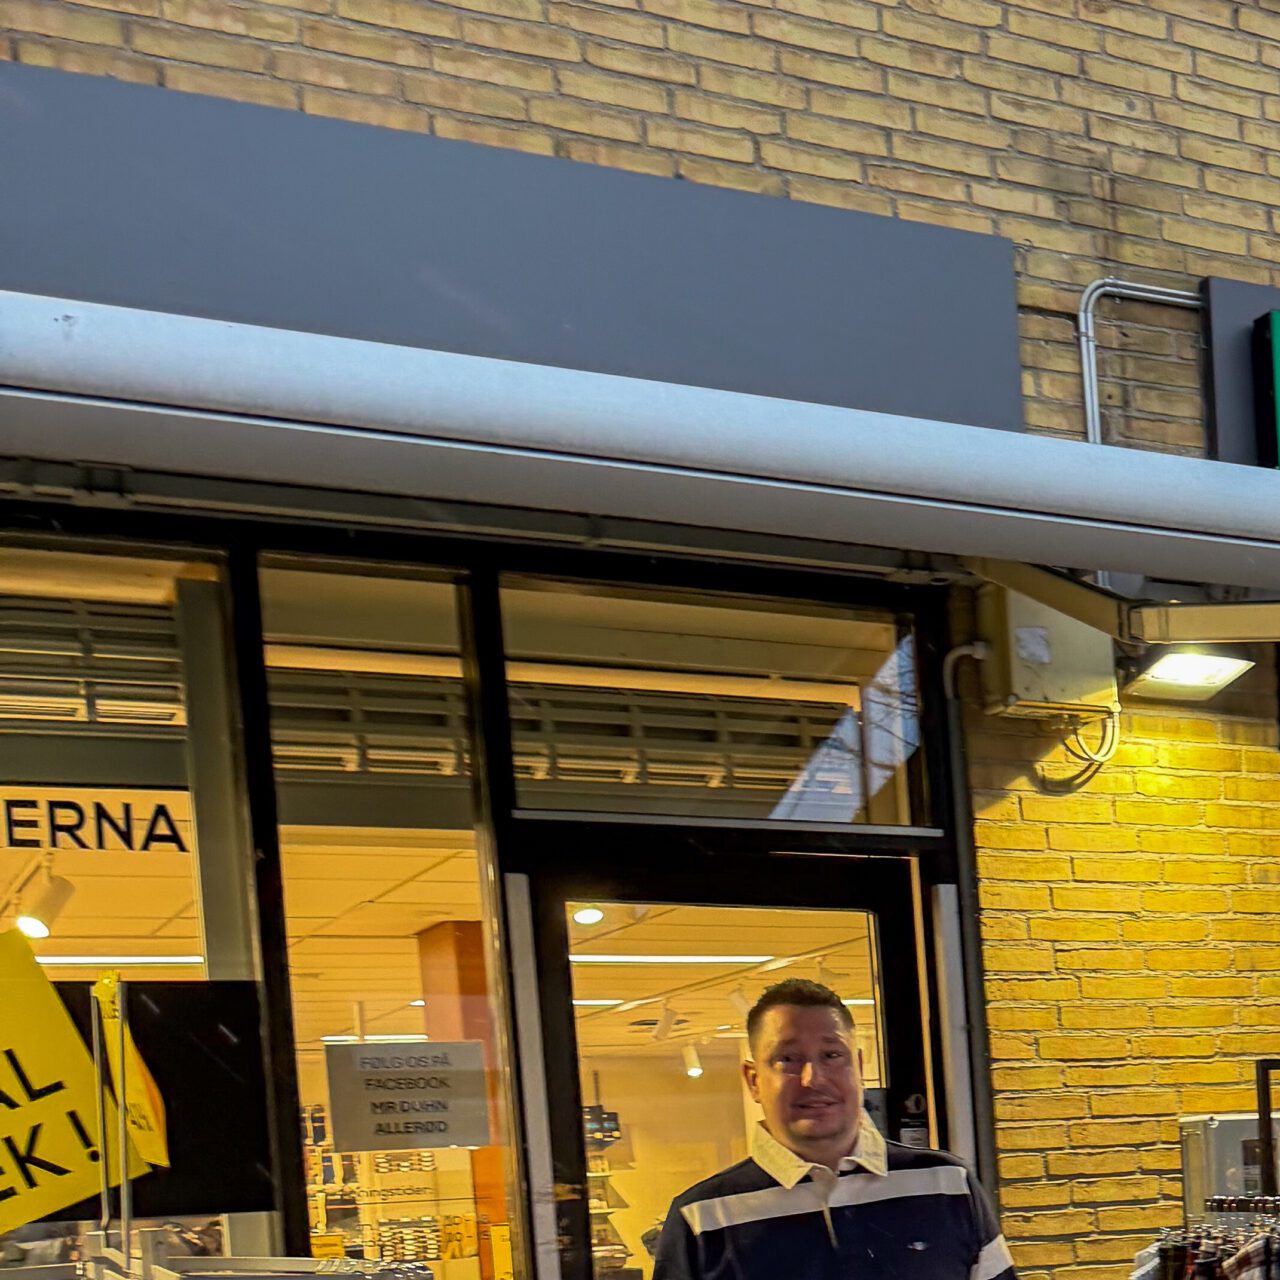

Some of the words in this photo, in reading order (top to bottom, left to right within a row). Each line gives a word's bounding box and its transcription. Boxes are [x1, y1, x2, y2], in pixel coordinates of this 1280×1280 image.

[4, 799, 190, 853] ERNA
[405, 1055, 430, 1068] OS
[364, 1076, 451, 1091] FACEBOOK
[370, 1101, 398, 1114] MR
[374, 1120, 449, 1136] ALLERØD
